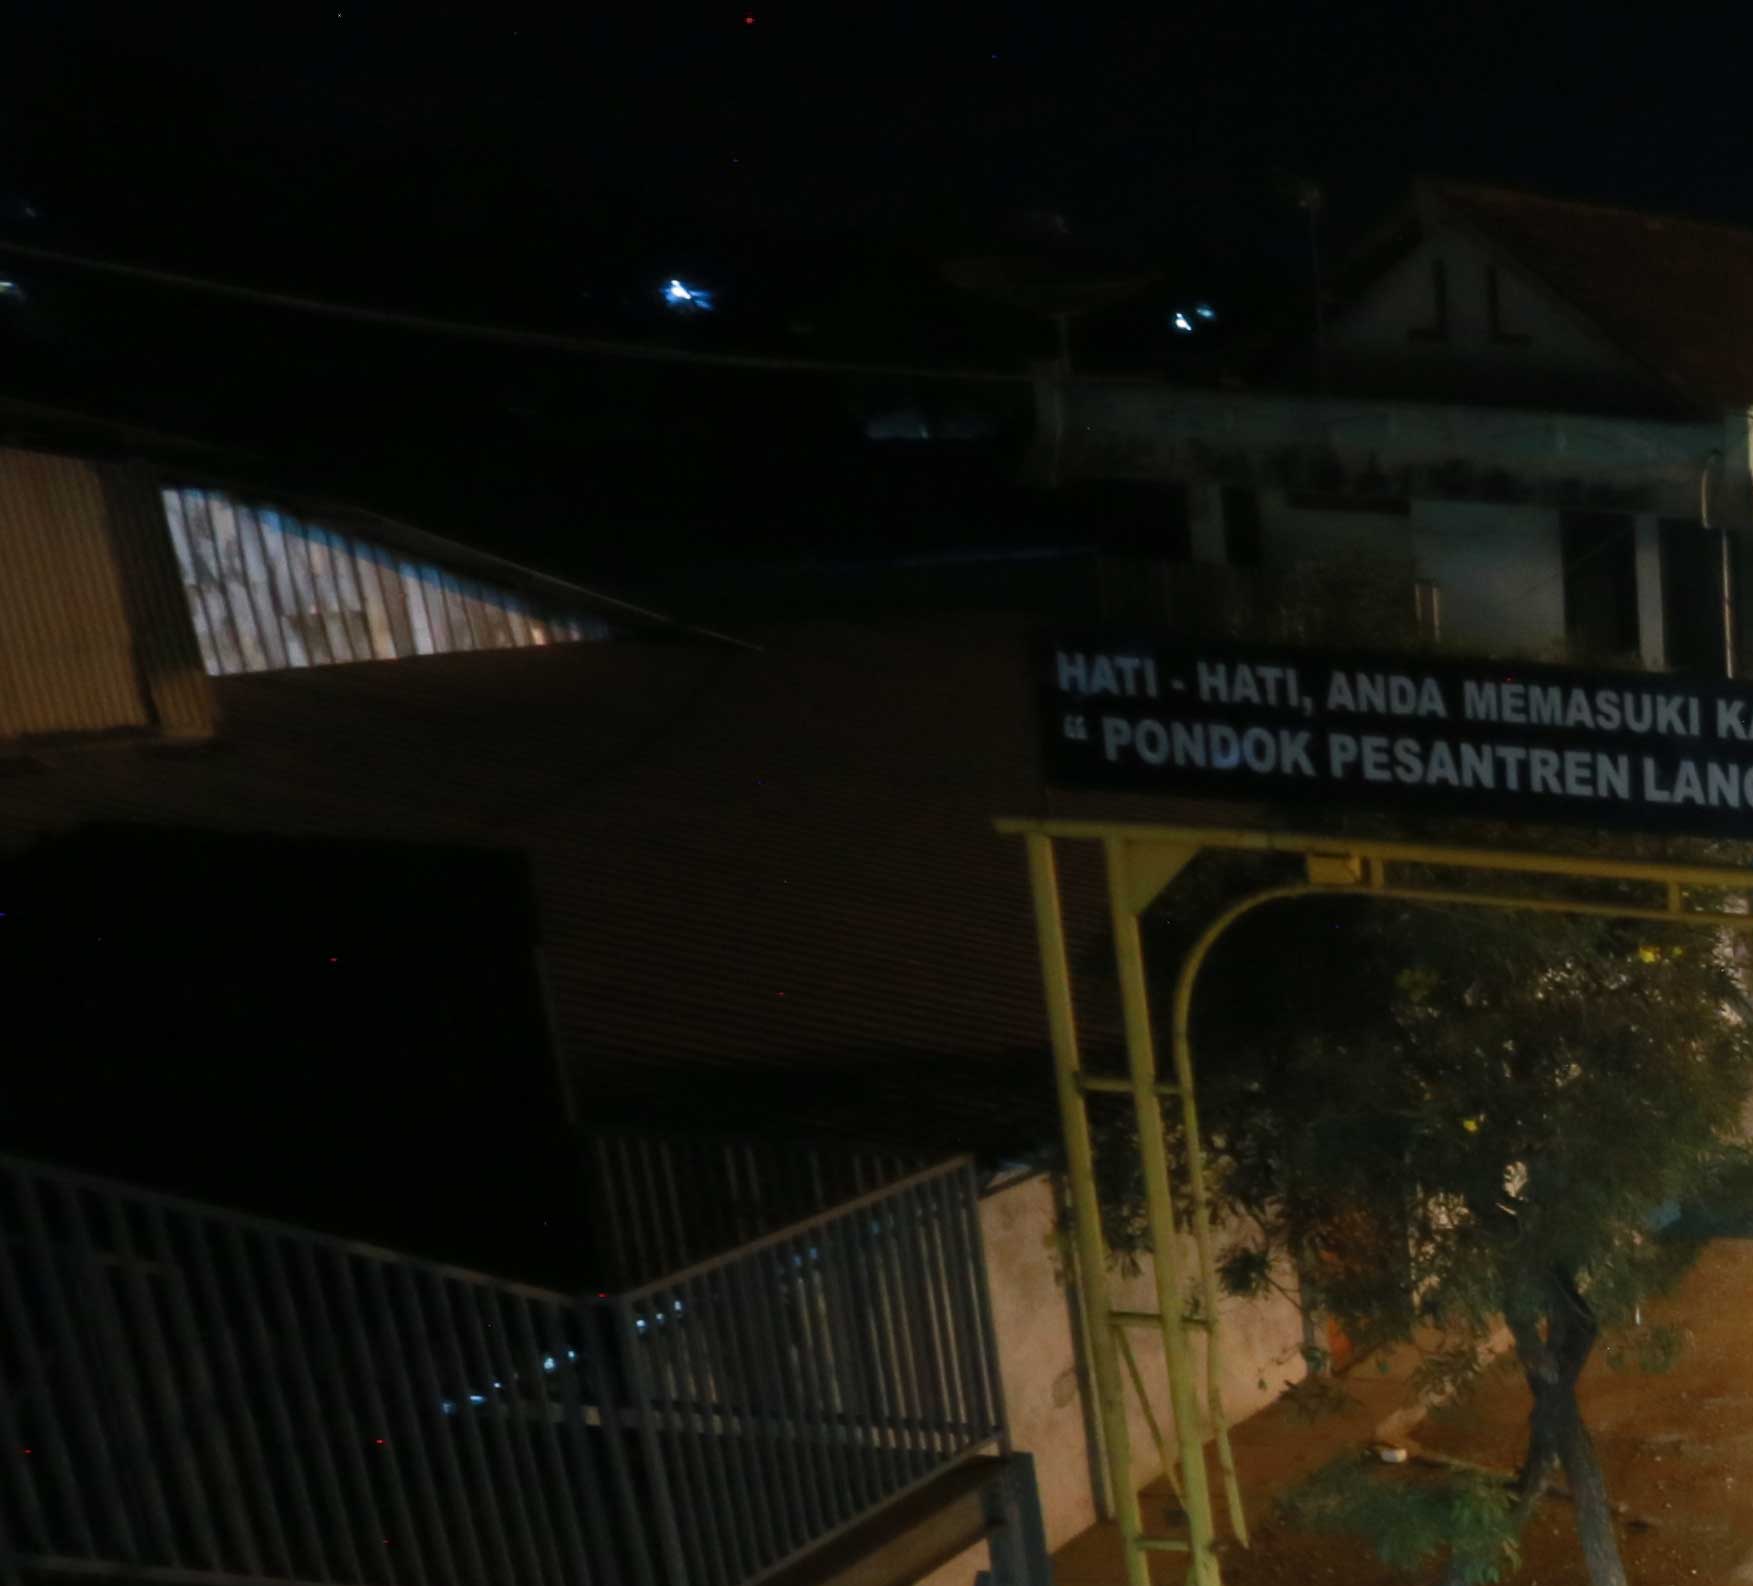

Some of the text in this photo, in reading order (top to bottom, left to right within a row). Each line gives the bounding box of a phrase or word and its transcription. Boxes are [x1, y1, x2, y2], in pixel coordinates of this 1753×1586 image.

[1056, 650, 1159, 698] HATI
[1196, 661, 1314, 717] HATI,
[1326, 669, 1449, 719] ANDA
[1463, 679, 1699, 737] MEMASUKI
[1101, 714, 1318, 778] PONDOK
[1328, 731, 1630, 799] PESANTREN
